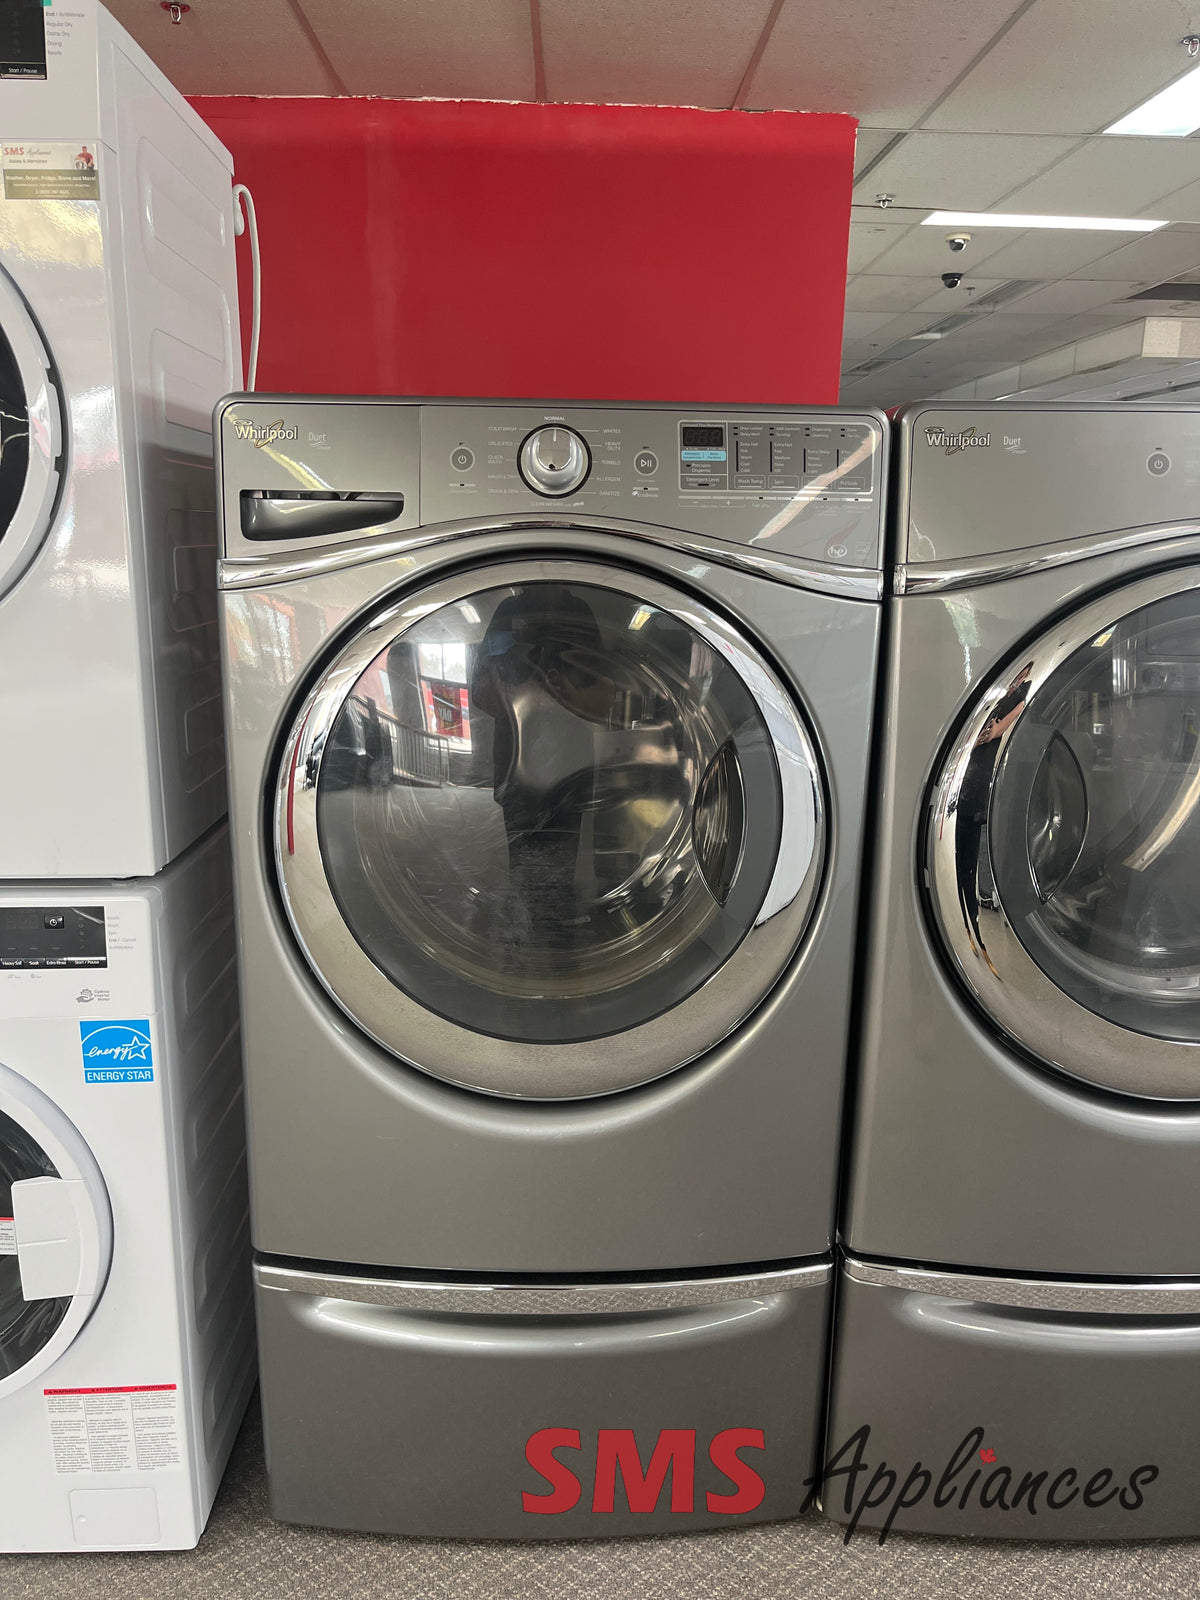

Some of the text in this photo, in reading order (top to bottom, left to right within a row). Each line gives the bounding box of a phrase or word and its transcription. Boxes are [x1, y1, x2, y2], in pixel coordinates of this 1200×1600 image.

[4, 147, 25, 156] SMS
[234, 424, 299, 445] Whirlpool
[308, 432, 327, 442] Duet
[926, 430, 991, 452] Whirlpool
[1003, 435, 1022, 447] Duet
[84, 1045, 130, 1061] energy
[87, 1070, 152, 1081] ENERGY STAR
